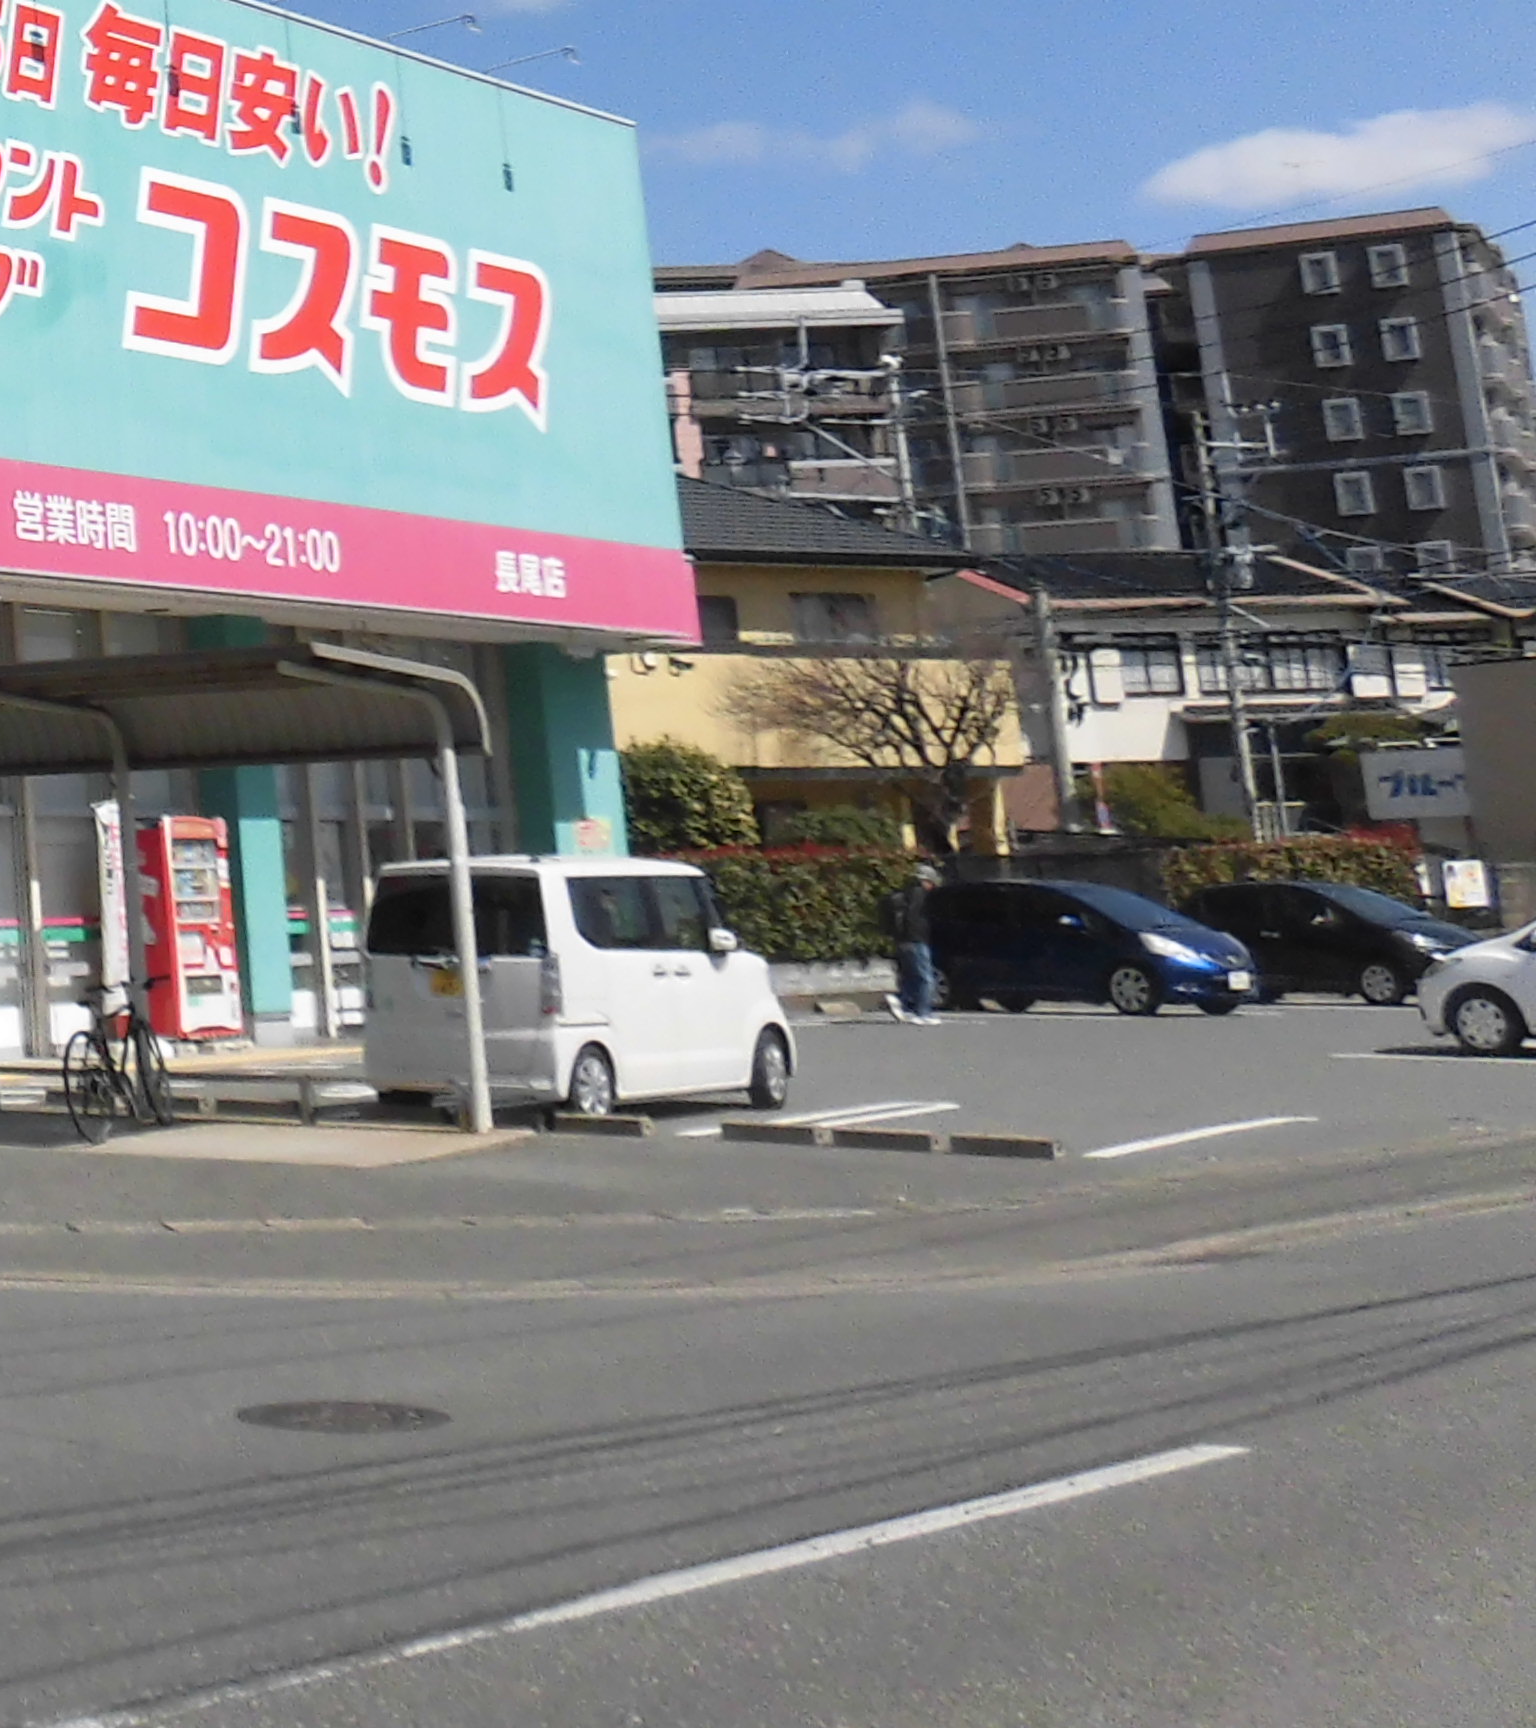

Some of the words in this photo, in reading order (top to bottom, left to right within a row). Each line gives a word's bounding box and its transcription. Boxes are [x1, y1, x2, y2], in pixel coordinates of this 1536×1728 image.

[122, 166, 549, 434] コスモス
[12, 489, 137, 553] 営業時間
